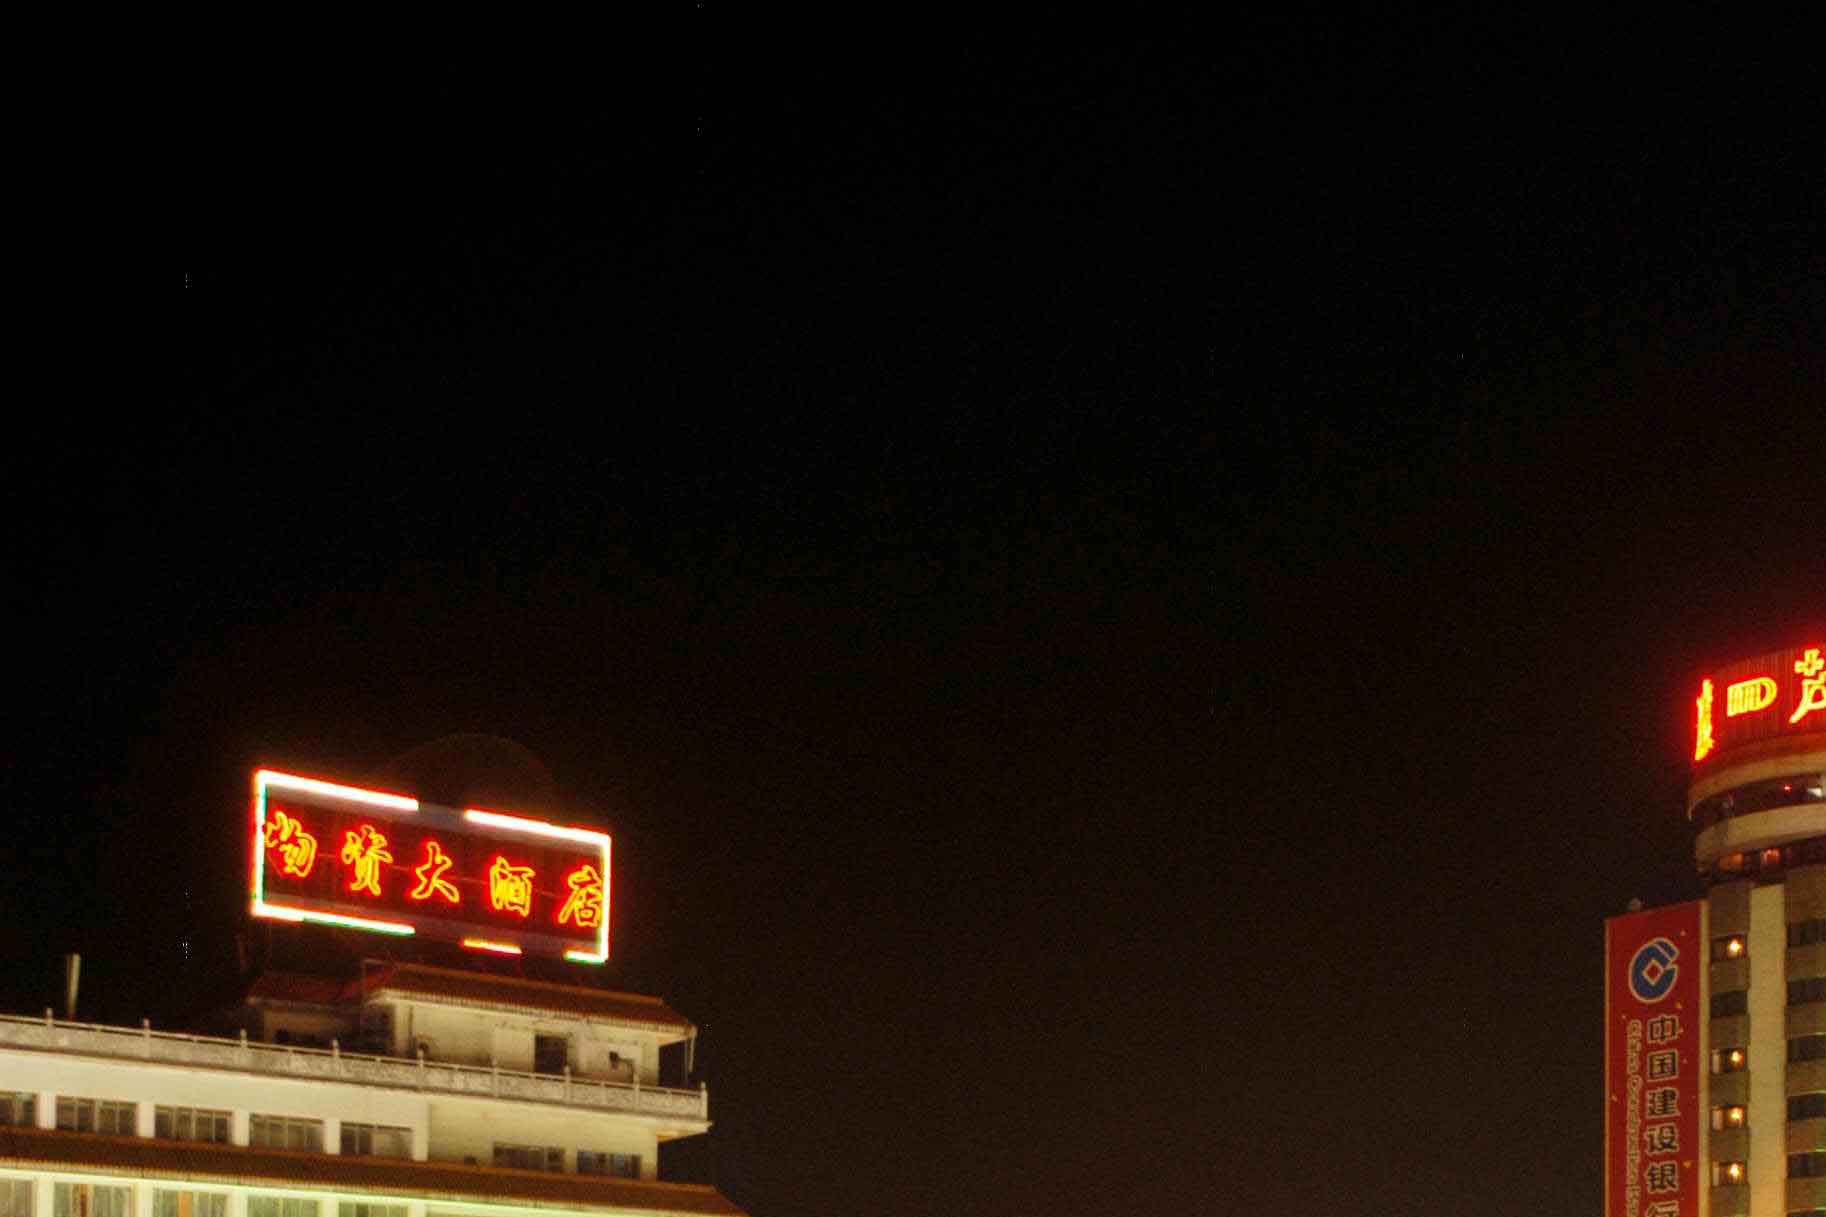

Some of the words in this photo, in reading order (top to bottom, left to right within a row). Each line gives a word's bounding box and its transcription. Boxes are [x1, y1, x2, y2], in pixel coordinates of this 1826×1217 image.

[265, 811, 602, 927] 物资大酒店
